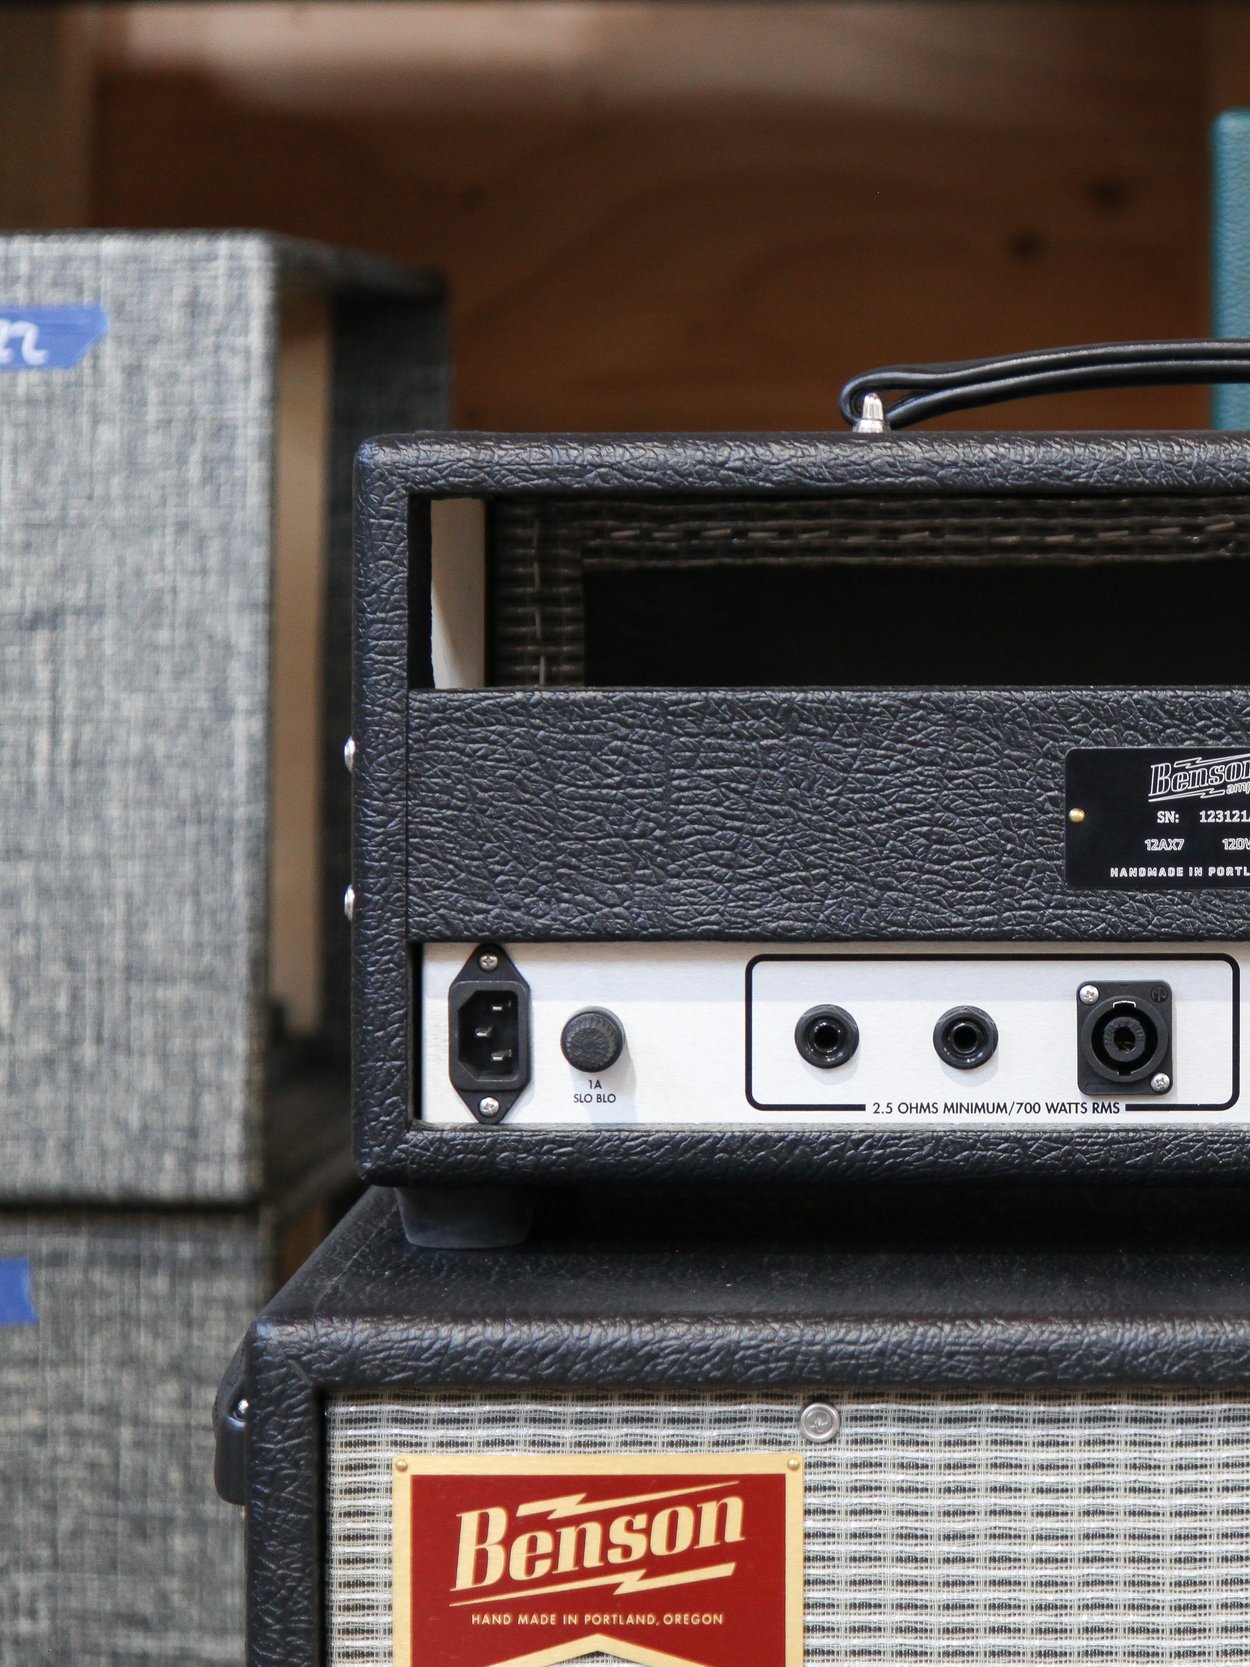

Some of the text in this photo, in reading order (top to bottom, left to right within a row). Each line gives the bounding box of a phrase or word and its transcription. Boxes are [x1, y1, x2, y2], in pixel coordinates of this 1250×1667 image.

[1156, 810, 1180, 824] SN:
[1144, 838, 1185, 852] 12AX7
[1110, 866, 1184, 878] HANDMADE
[1188, 866, 1203, 877] IN
[588, 1079, 603, 1090] 1A
[573, 1093, 617, 1104] SLO BLO
[872, 1101, 1121, 1116] 2.5 OHMS MINIMUM/700 WATTS RMS
[449, 1495, 746, 1592] Benson
[471, 1613, 723, 1626] HAND MADE IN PORTLAND, OREGON
